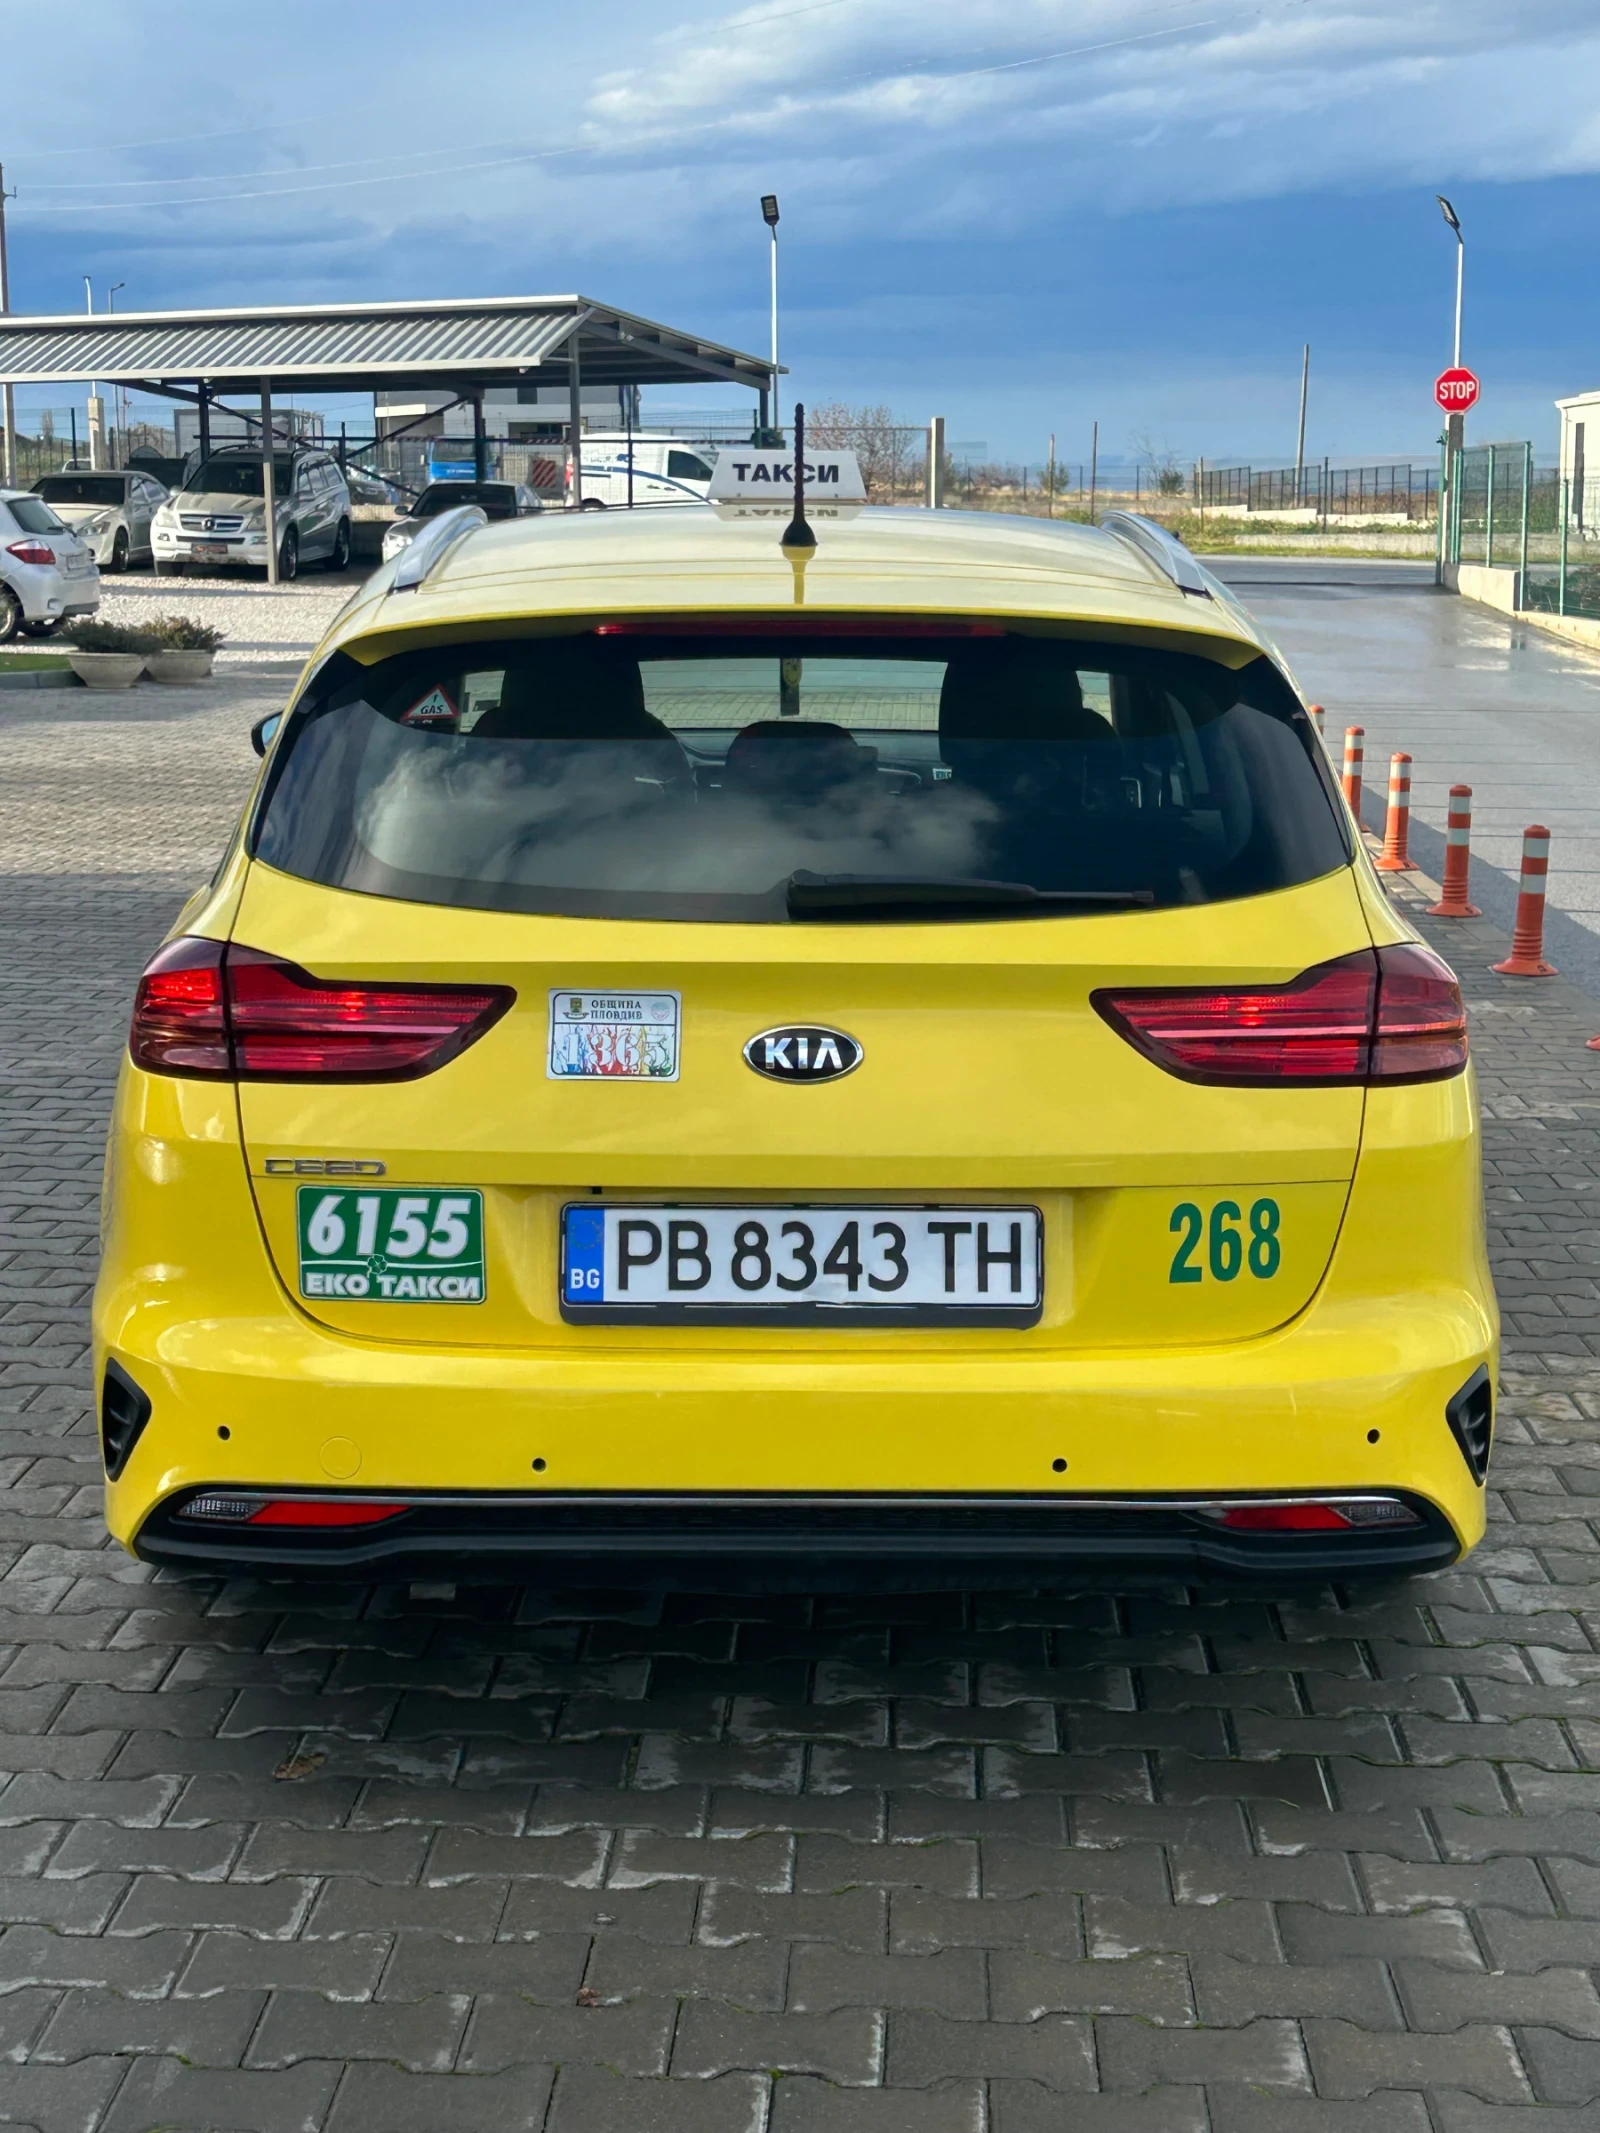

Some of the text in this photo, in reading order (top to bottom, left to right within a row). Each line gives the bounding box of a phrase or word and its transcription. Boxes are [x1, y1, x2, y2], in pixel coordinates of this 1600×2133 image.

[1439, 381, 1476, 400] STOP
[732, 463, 839, 483] ТАКСИ
[420, 704, 444, 714] GAS
[590, 1010, 643, 1021] ПЛОВДИВ
[591, 999, 642, 1009] ОБЩИНА
[565, 1033, 669, 1067] 1365
[763, 1037, 843, 1069] KIA
[307, 1194, 472, 1258] 6155
[1169, 1197, 1281, 1283] 268
[618, 1220, 1023, 1293] PB 8343 TH
[306, 1272, 481, 1299] ЕКО ТАКСИ
[570, 1268, 600, 1290] BG
